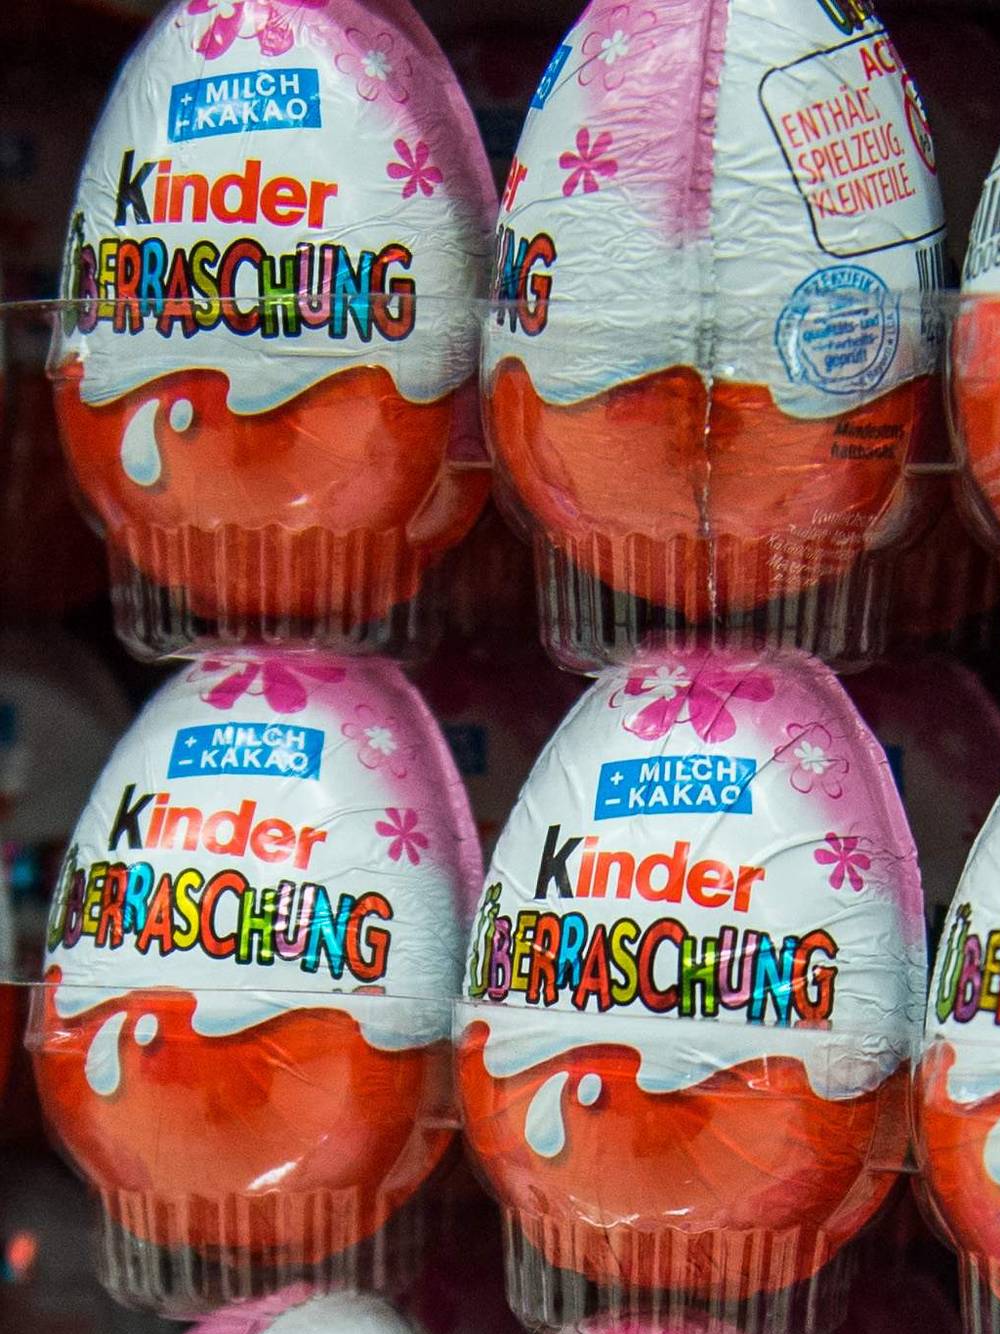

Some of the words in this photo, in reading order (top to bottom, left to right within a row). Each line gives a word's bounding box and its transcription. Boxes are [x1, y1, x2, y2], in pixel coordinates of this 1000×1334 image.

[205, 73, 300, 101] MILCH
[197, 97, 309, 129] KAKAO
[797, 123, 905, 185] SPIELZEUG.
[115, 150, 338, 228] Kinder
[212, 723, 306, 749] MILCH
[200, 749, 310, 771] KAKAO
[639, 760, 738, 784] MILCH
[627, 784, 741, 810] KAKAO
[108, 784, 328, 870] Kinder
[534, 824, 766, 914] Kinder
[48, 843, 394, 983] ÜBERRASCHUNG
[468, 882, 839, 1022] ÜBERRASCHUNG
